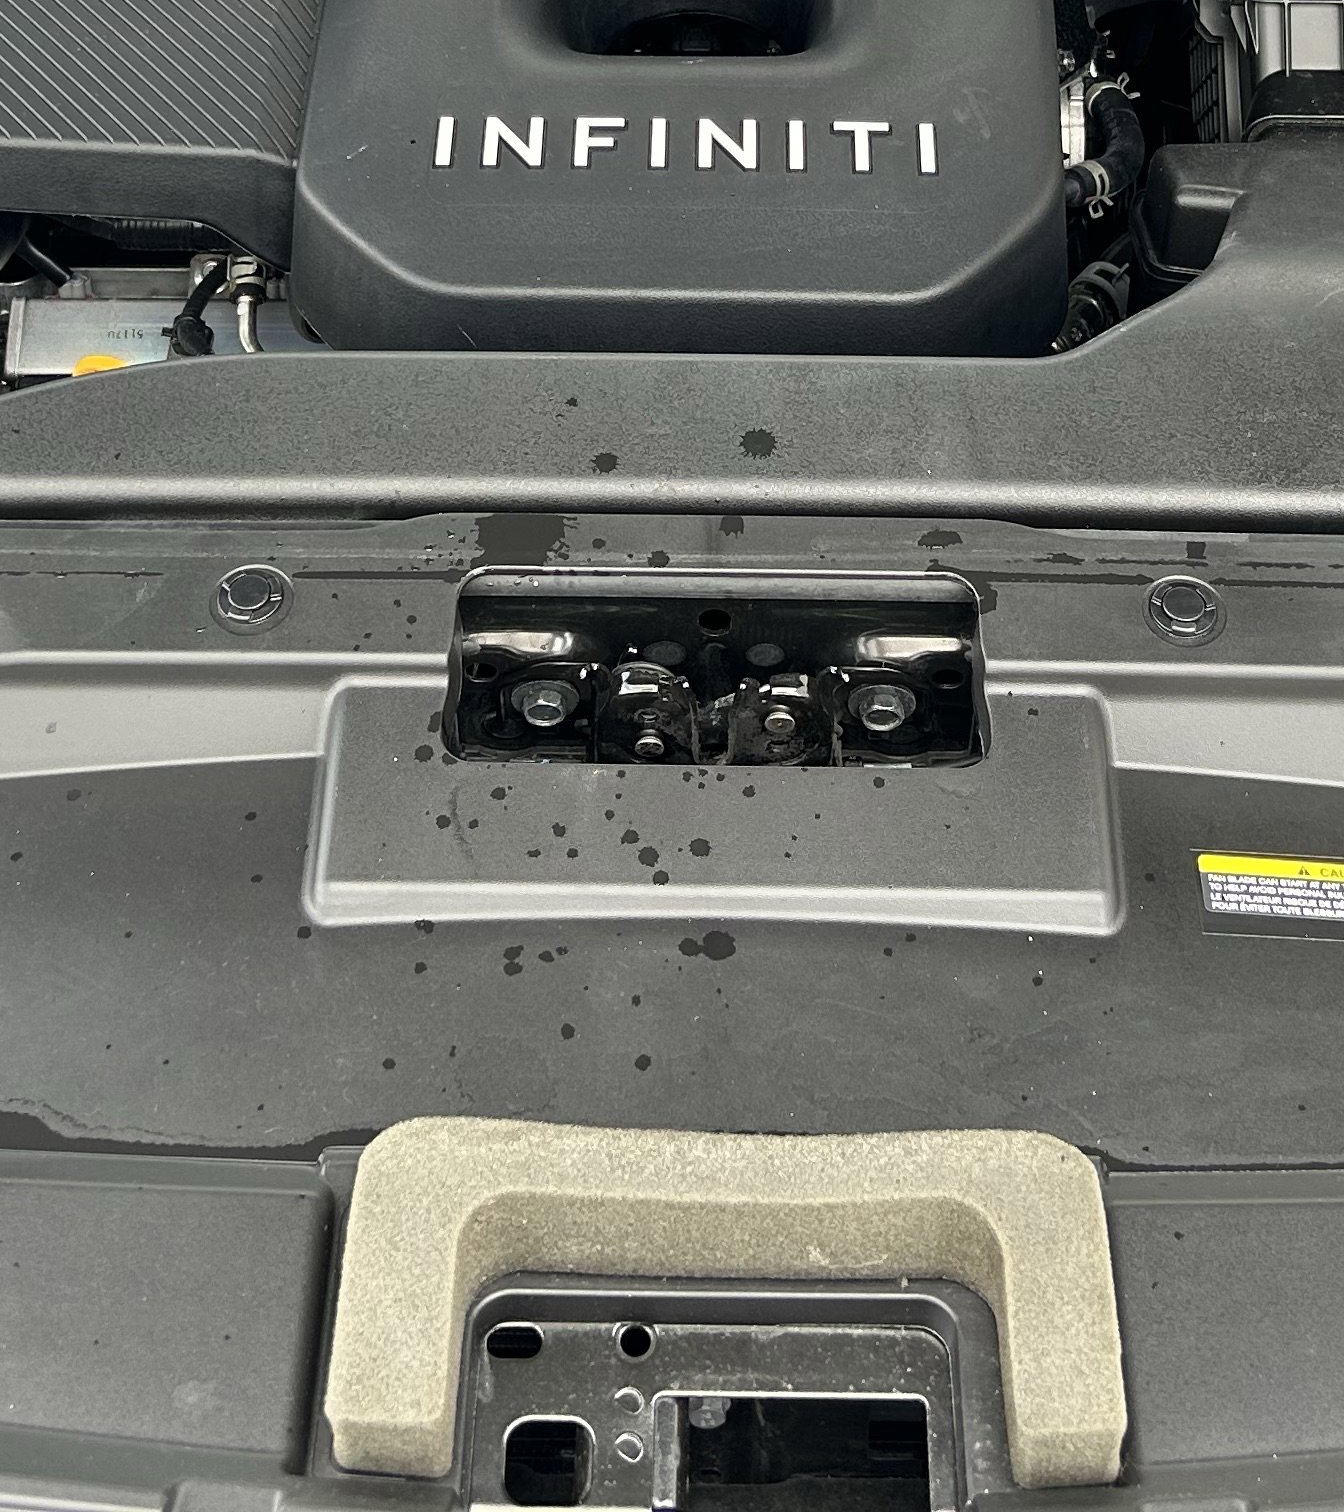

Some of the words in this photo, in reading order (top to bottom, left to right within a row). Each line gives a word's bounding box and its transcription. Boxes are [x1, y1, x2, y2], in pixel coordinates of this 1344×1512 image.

[433, 116, 937, 174] INFINITI
[1208, 882, 1223, 891] TO
[1223, 883, 1248, 893] HELP
[1248, 885, 1277, 895] AVOID
[1257, 877, 1279, 886] CAN
[1279, 879, 1308, 888] START
[1321, 881, 1340, 891] ANY
[1223, 893, 1282, 905] VENTILATEUR
[1211, 901, 1240, 911] POUR
